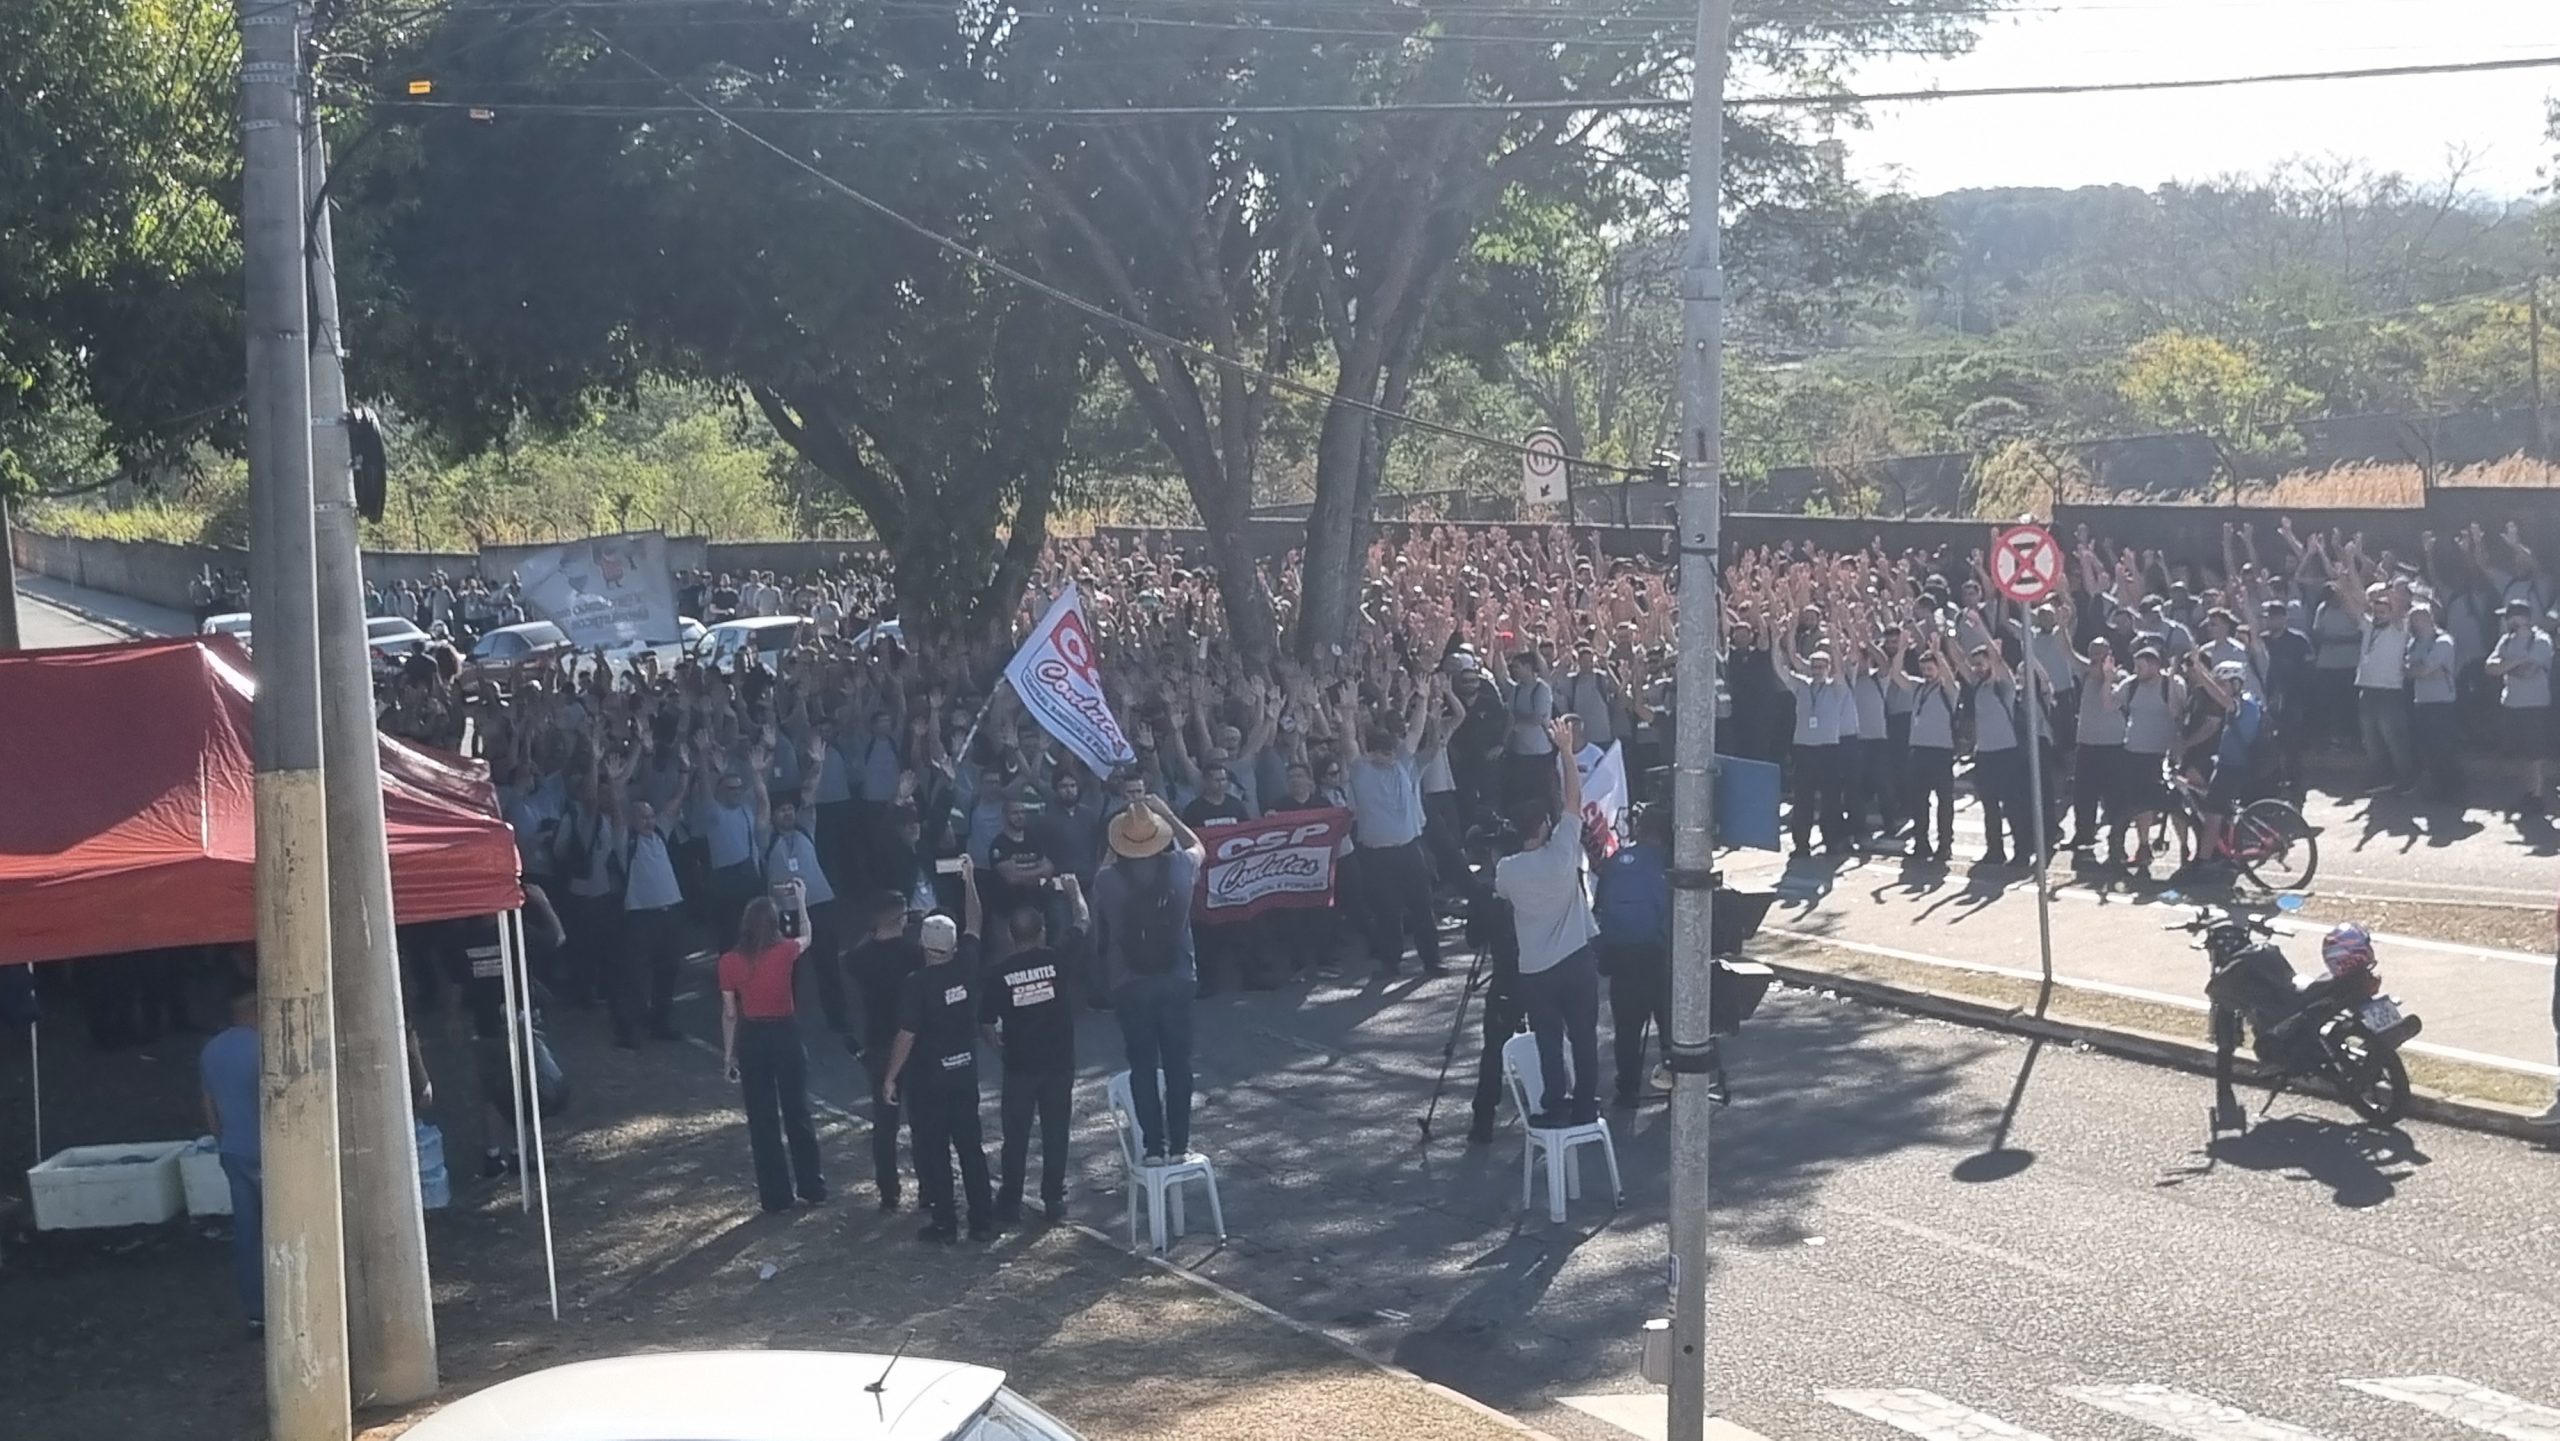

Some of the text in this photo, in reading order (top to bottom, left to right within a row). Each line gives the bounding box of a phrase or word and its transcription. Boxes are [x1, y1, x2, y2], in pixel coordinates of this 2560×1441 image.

[1217, 823, 1330, 860] CSP
[1218, 852, 1320, 896] Conlutas
[1004, 965, 1057, 987] VIGILANTES
